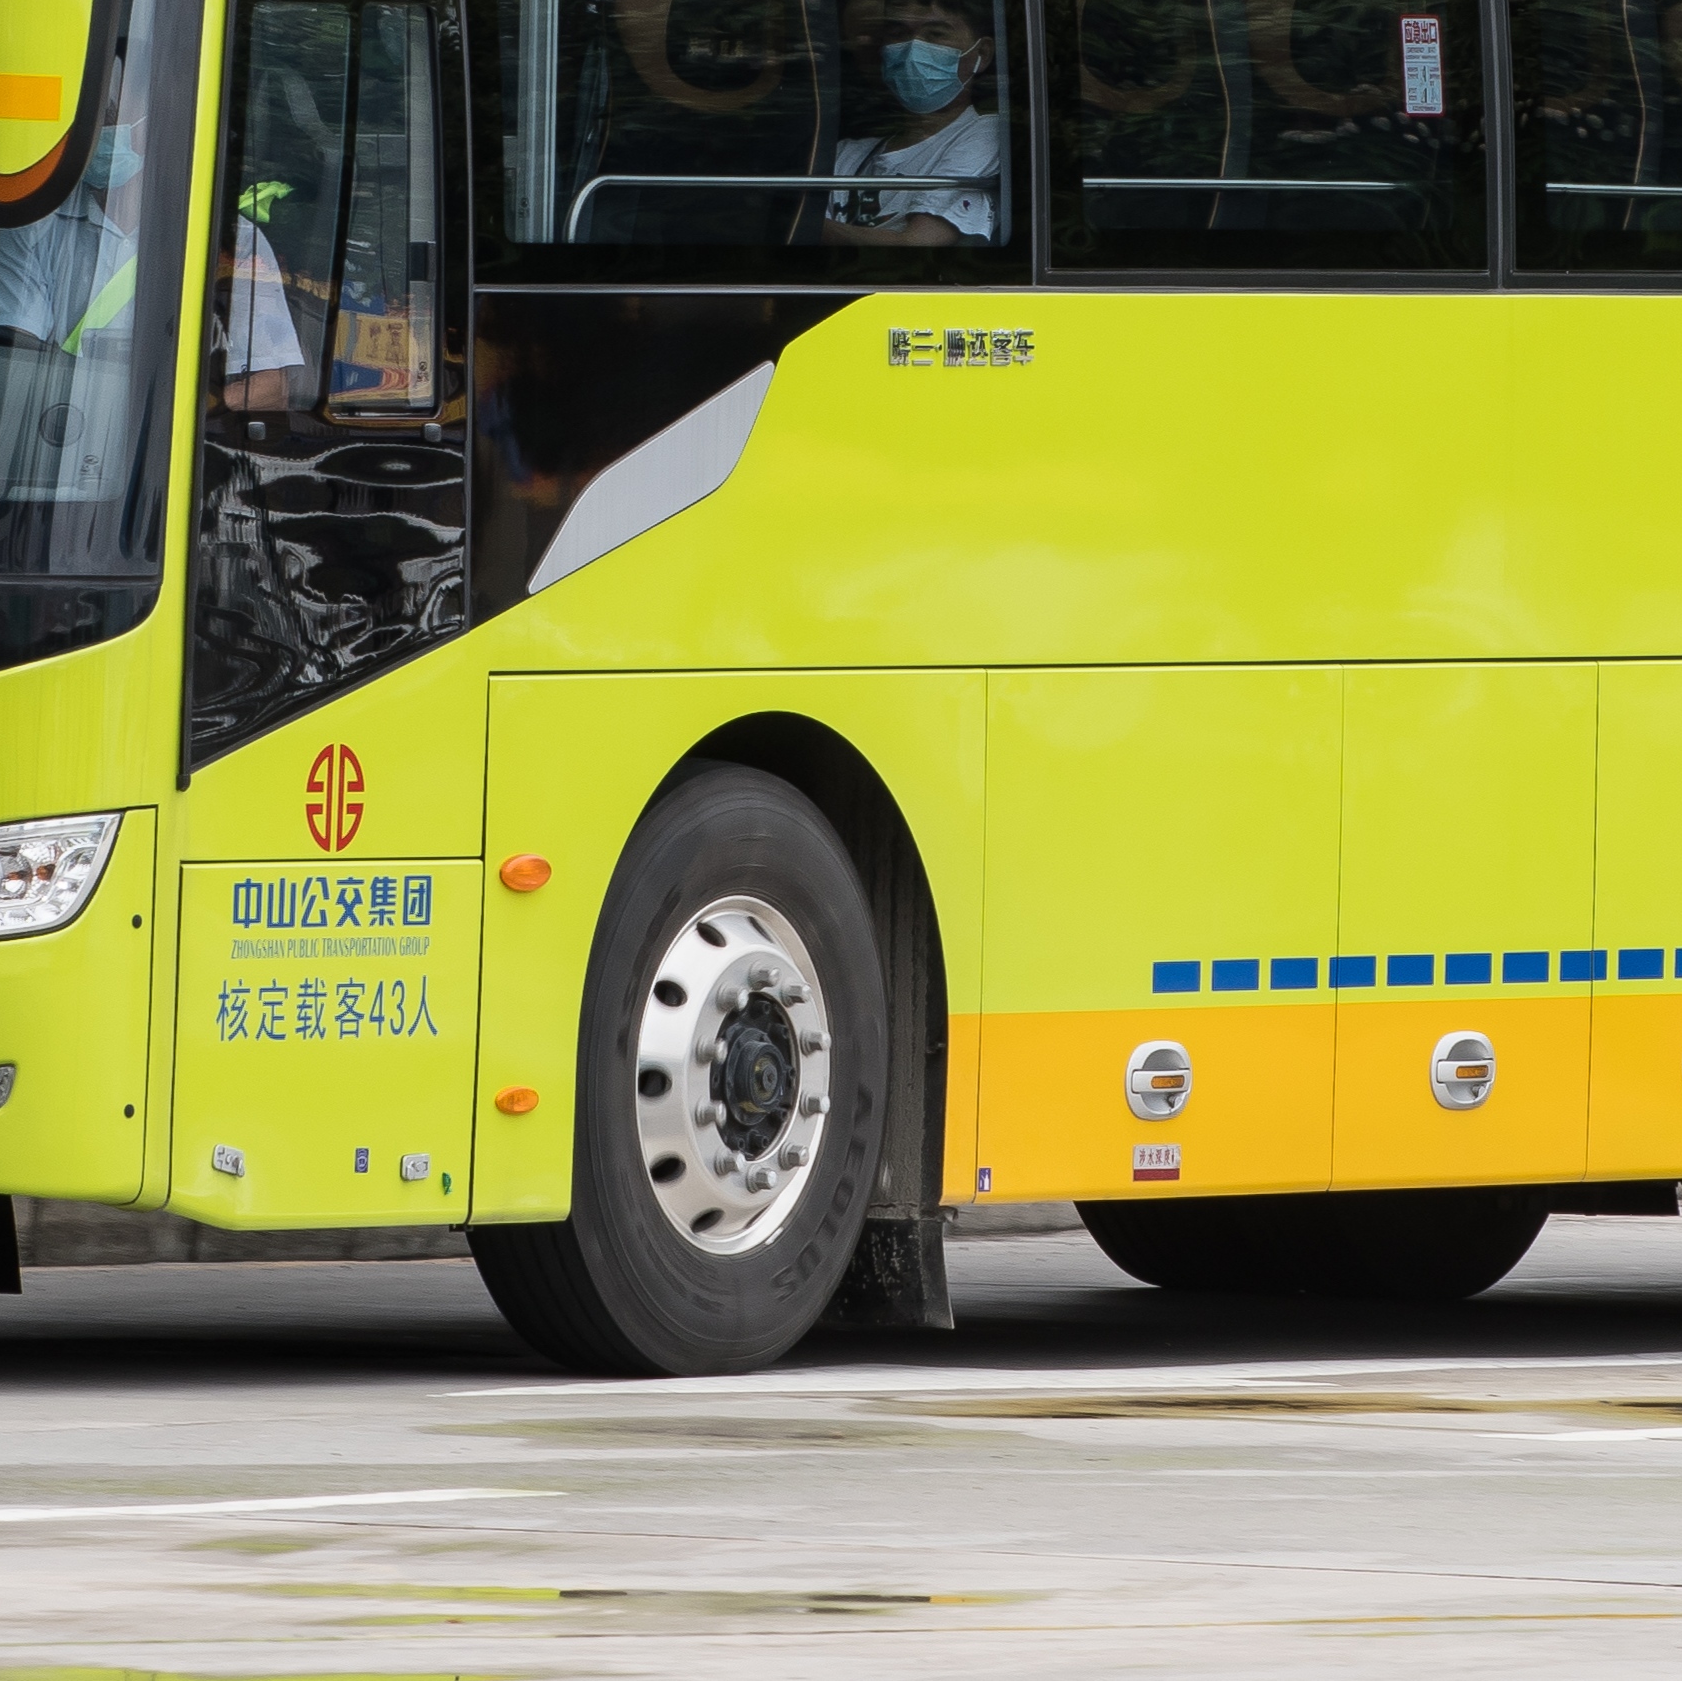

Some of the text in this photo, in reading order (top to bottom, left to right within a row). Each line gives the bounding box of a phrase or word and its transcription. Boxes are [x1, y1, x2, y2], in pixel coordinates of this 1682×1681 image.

[232, 875, 433, 929] 中山公交集团
[230, 936, 430, 959] ZHONGSHAN PUBLIC TRANSPORTATION GROUP
[216, 974, 439, 1042] 核定载客43人
